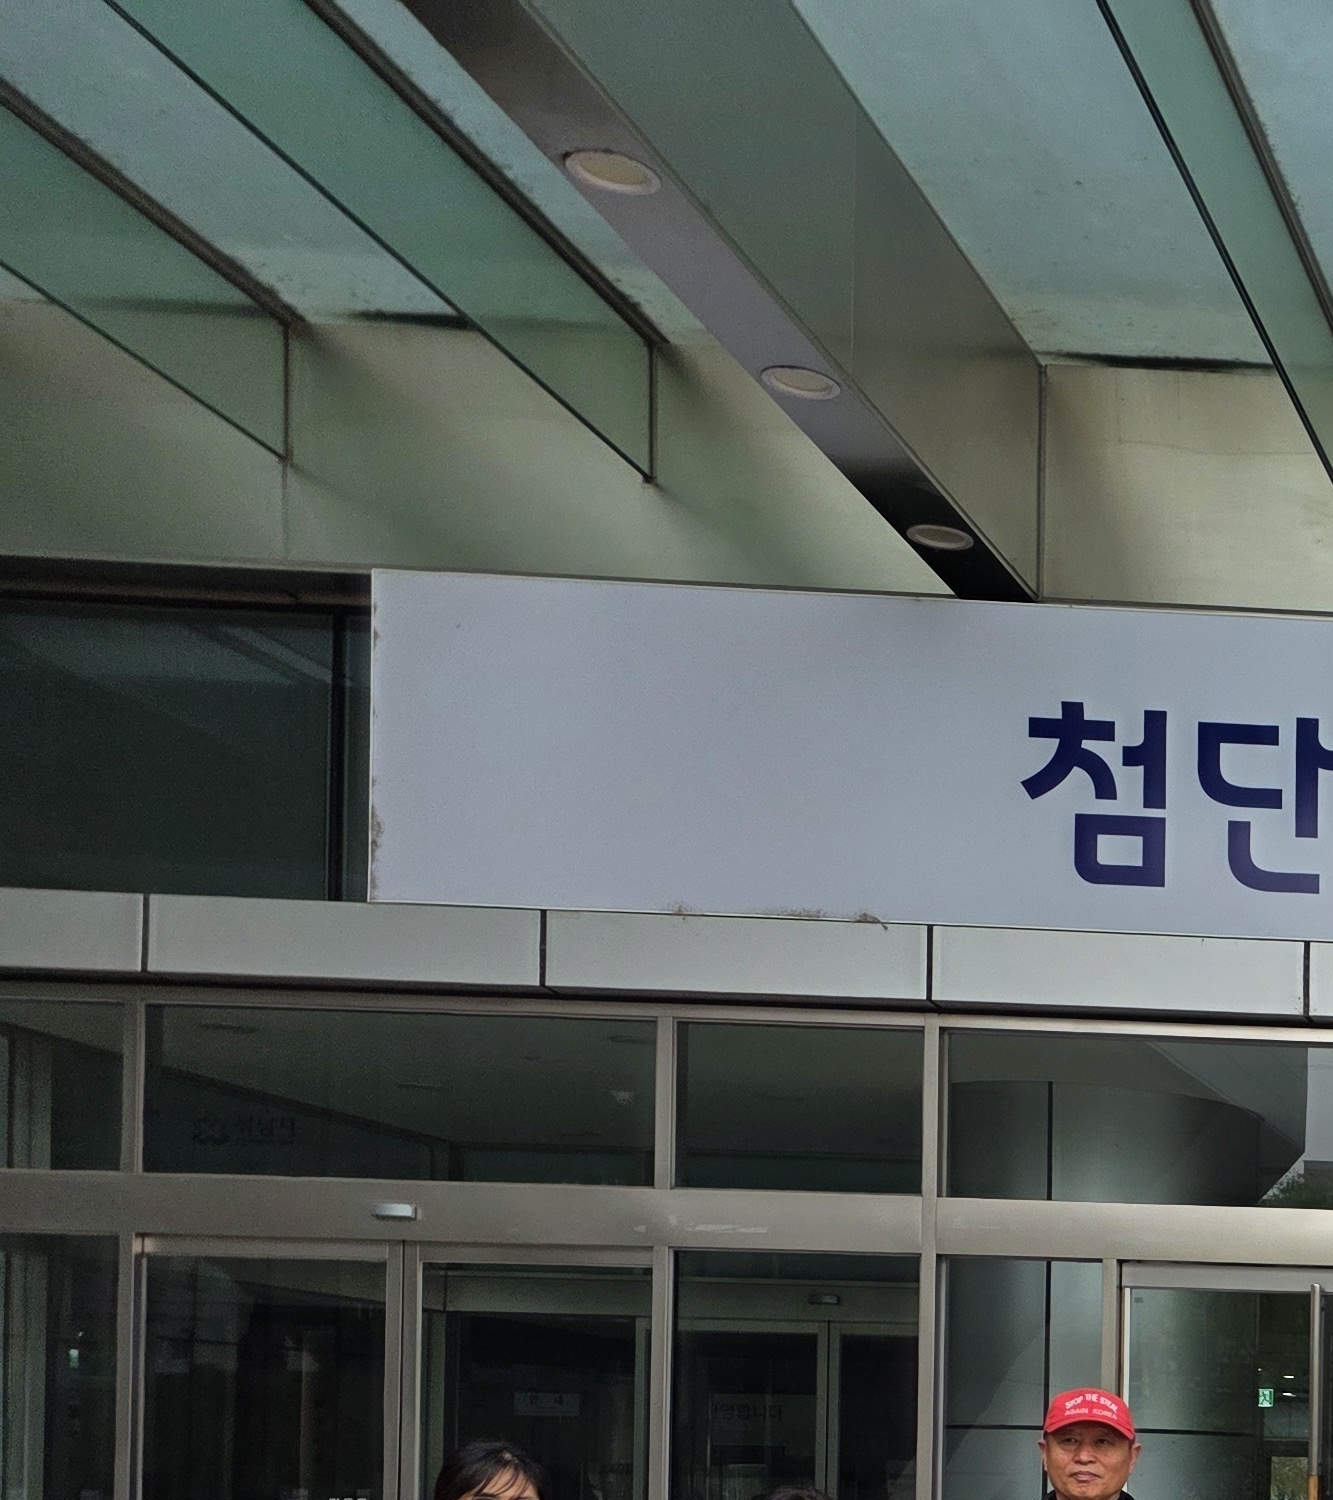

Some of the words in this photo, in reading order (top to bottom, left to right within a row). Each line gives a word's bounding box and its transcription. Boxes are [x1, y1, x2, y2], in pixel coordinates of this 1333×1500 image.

[1064, 1395, 1084, 1410] STOP
[1084, 1393, 1099, 1403] THE
[1064, 1407, 1089, 1416] AGAIN
[1092, 1408, 1118, 1420] KOREA
